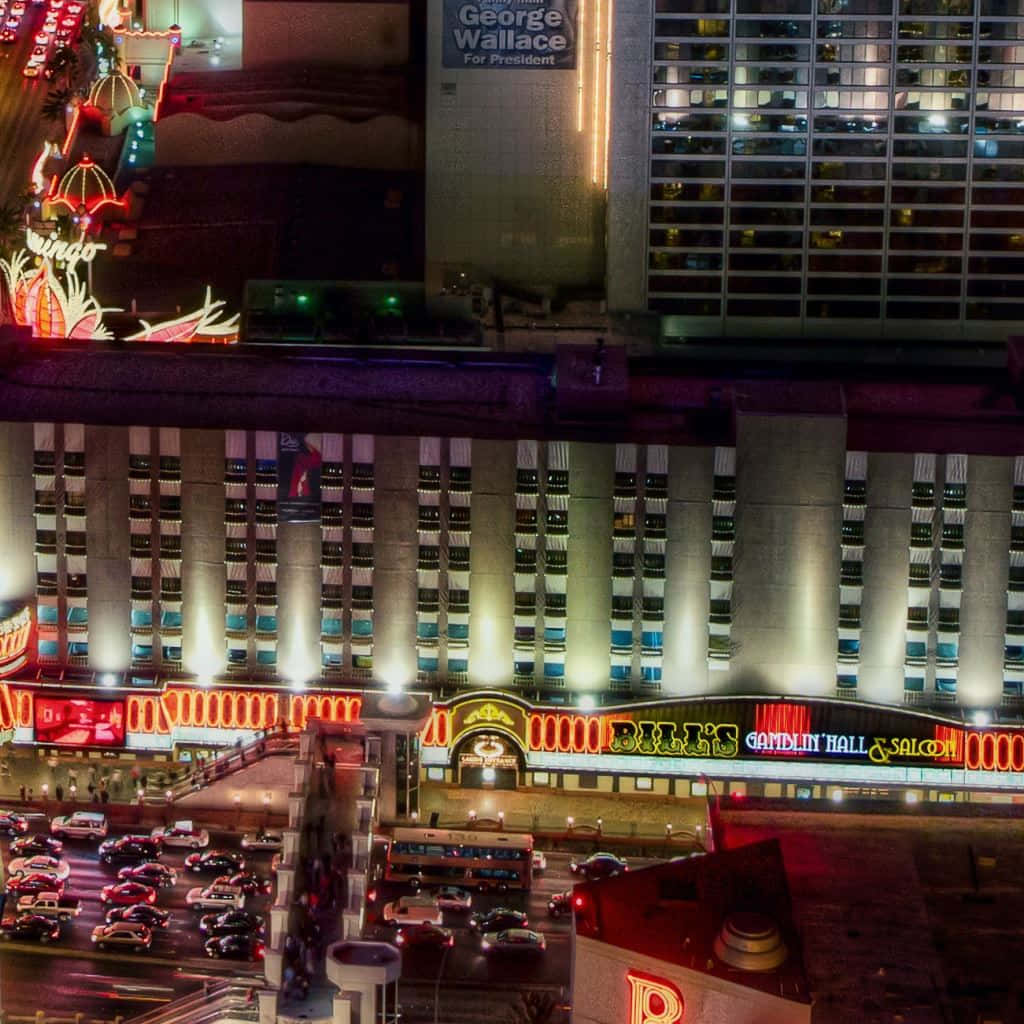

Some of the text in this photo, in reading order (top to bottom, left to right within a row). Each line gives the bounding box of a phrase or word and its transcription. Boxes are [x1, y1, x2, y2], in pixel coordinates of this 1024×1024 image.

[459, 4, 563, 31] George
[453, 29, 567, 51] Wallace
[463, 52, 555, 66] For President
[610, 721, 739, 757] BILL'S
[826, 735, 868, 755] HALL
[868, 737, 891, 764] &
[890, 737, 957, 757] SALOON
